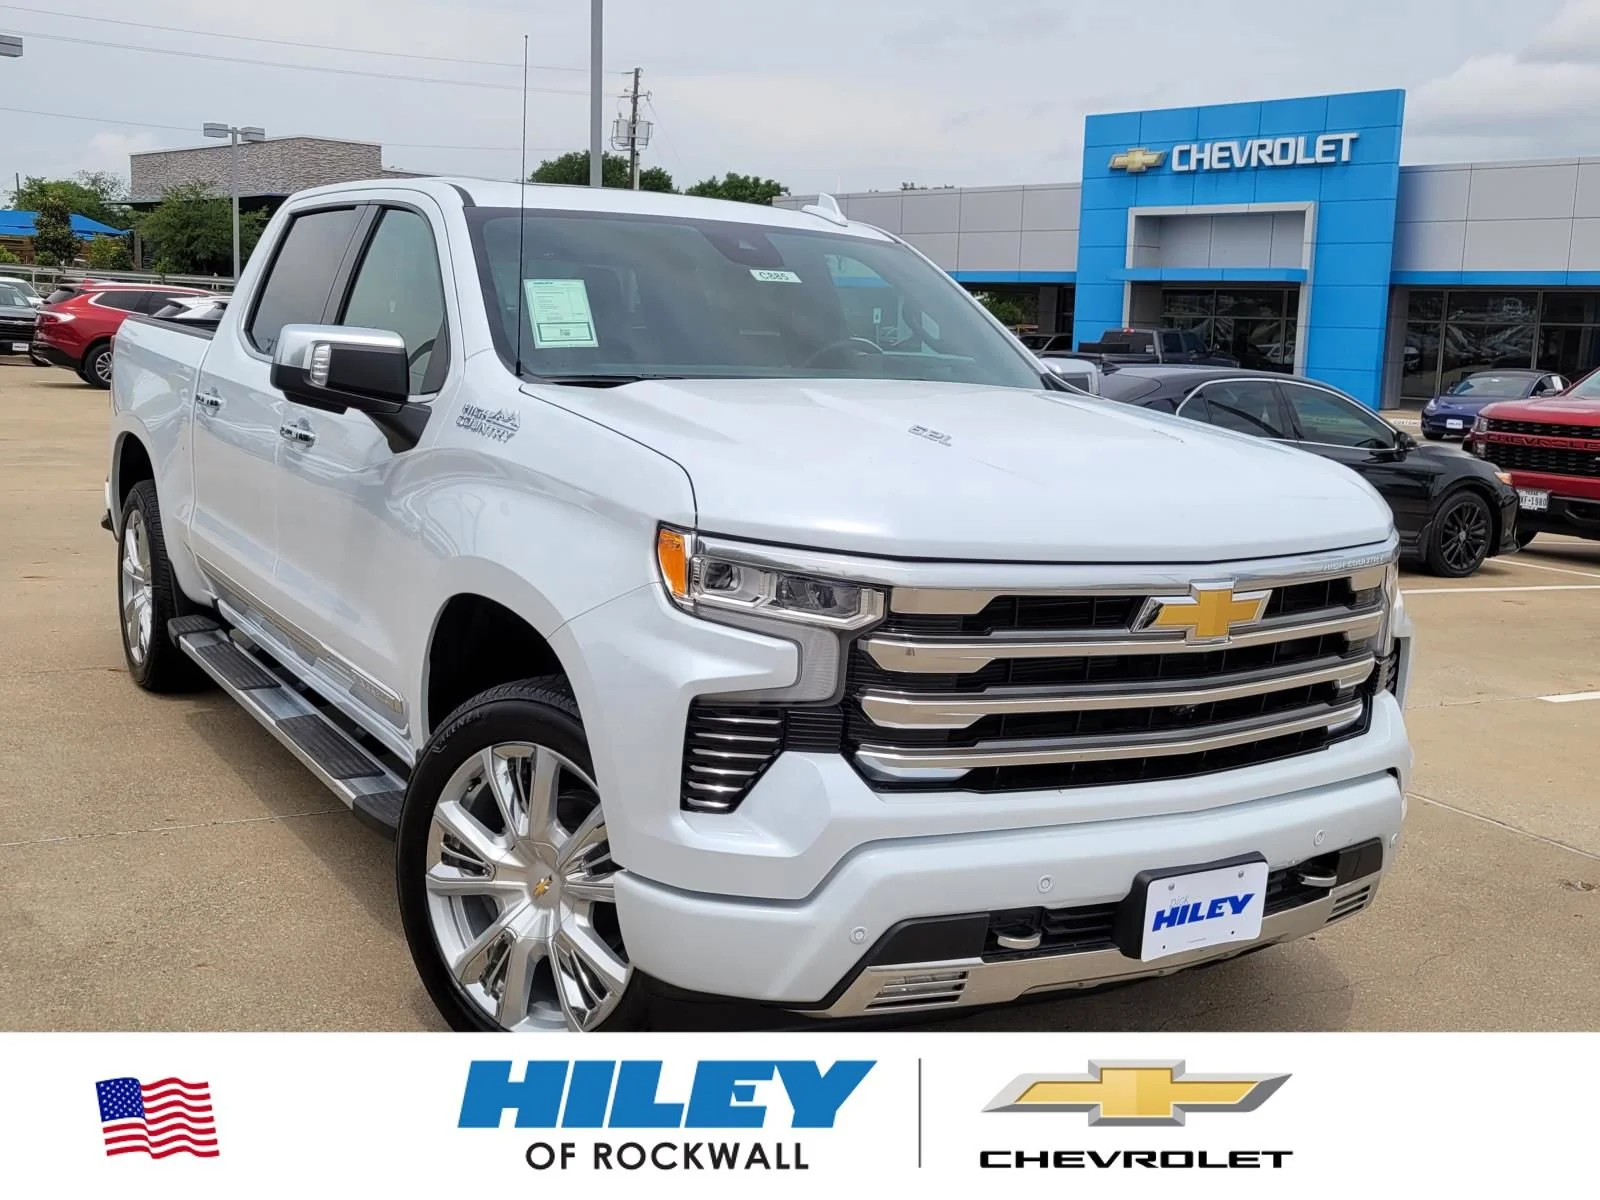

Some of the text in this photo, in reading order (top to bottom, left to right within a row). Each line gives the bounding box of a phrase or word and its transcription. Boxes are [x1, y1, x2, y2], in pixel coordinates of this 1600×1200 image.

[1171, 132, 1359, 172] CHEVROLET
[456, 415, 516, 443] COUNTRY
[1487, 432, 1600, 451] CHEVROLE
[1347, 554, 1384, 568] COUNTRY
[1152, 893, 1255, 932] HILEY
